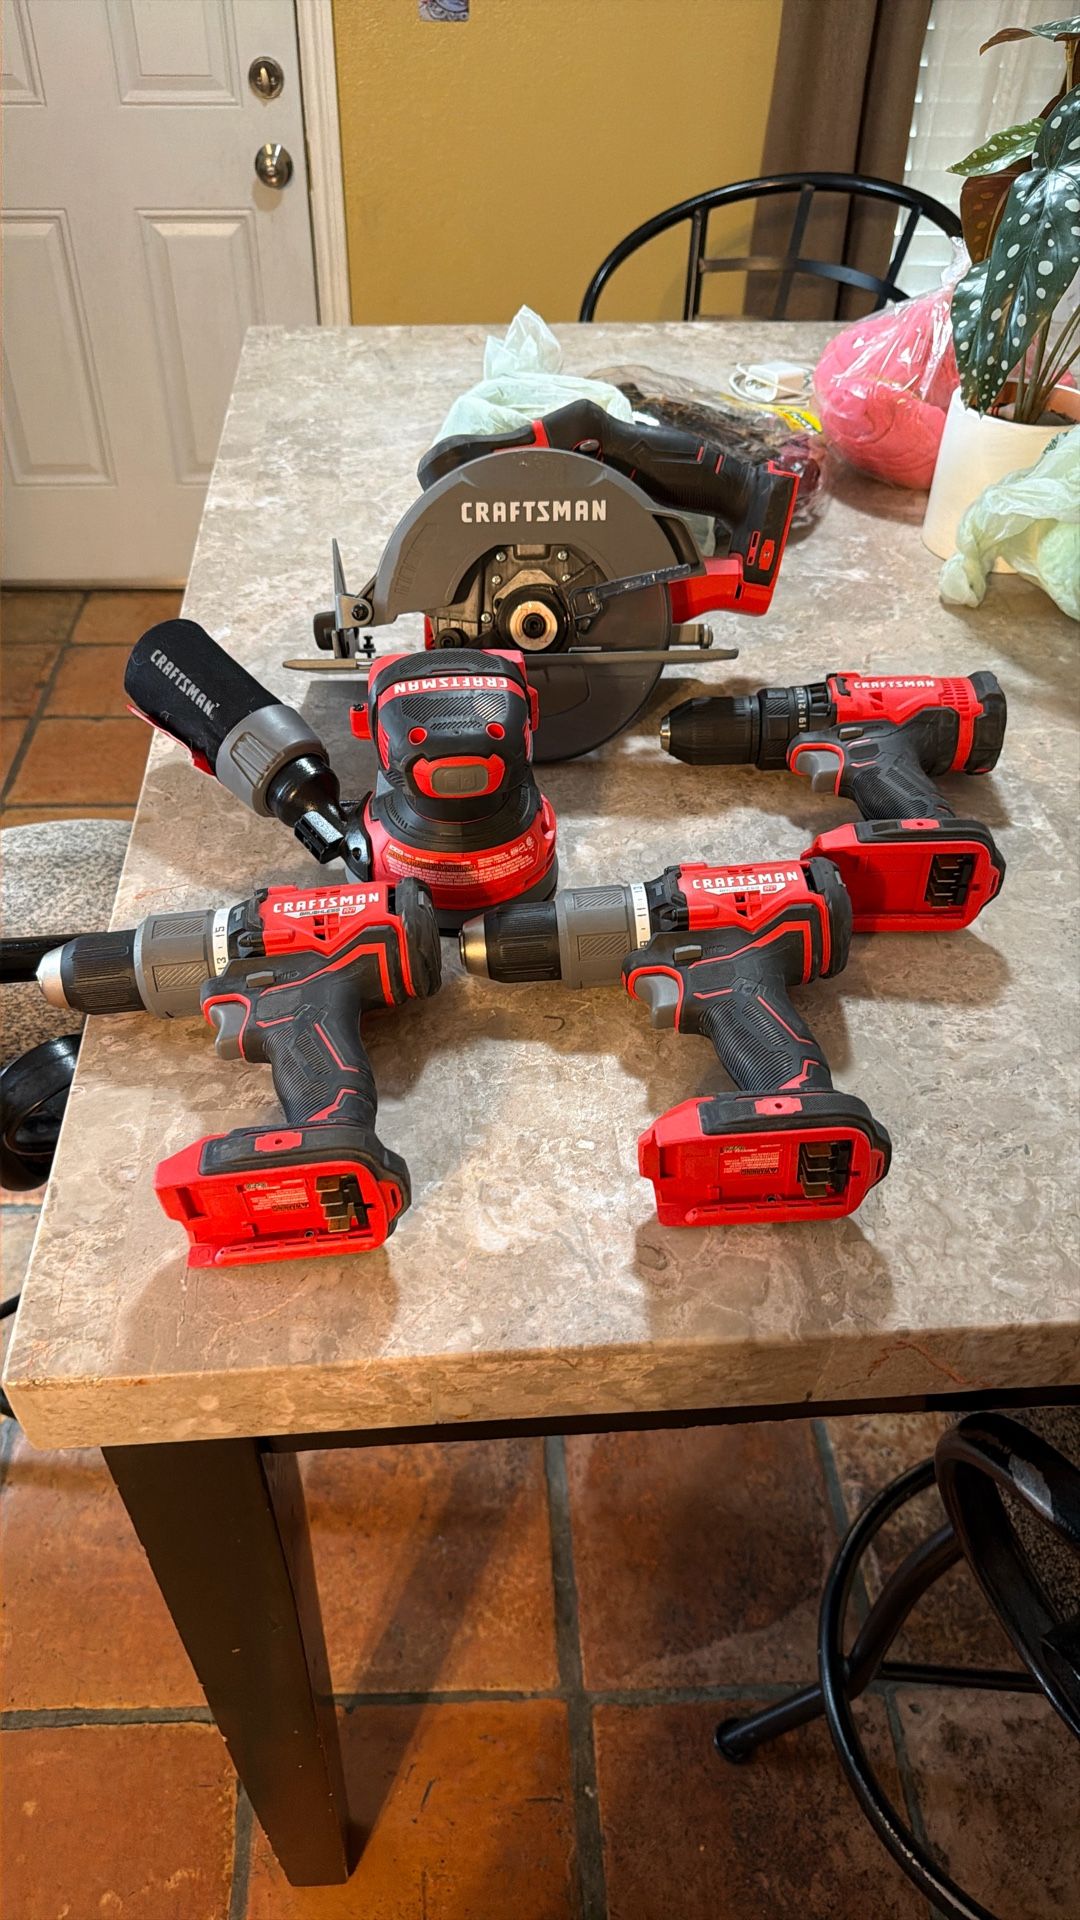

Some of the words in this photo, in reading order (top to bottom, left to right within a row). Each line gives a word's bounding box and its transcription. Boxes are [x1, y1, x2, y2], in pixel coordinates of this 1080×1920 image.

[461, 499, 607, 523] CRAFTSMAN
[150, 649, 216, 717] CRAFTSMAN
[394, 676, 508, 695] CRAFTSMAN
[853, 680, 936, 689] CRAFTSMAN
[693, 871, 799, 890] CRAFTSMAN
[273, 892, 380, 914] CRAFTSMAN
[299, 907, 341, 917] BRUSHLESS
[214, 926, 226, 938] 15
